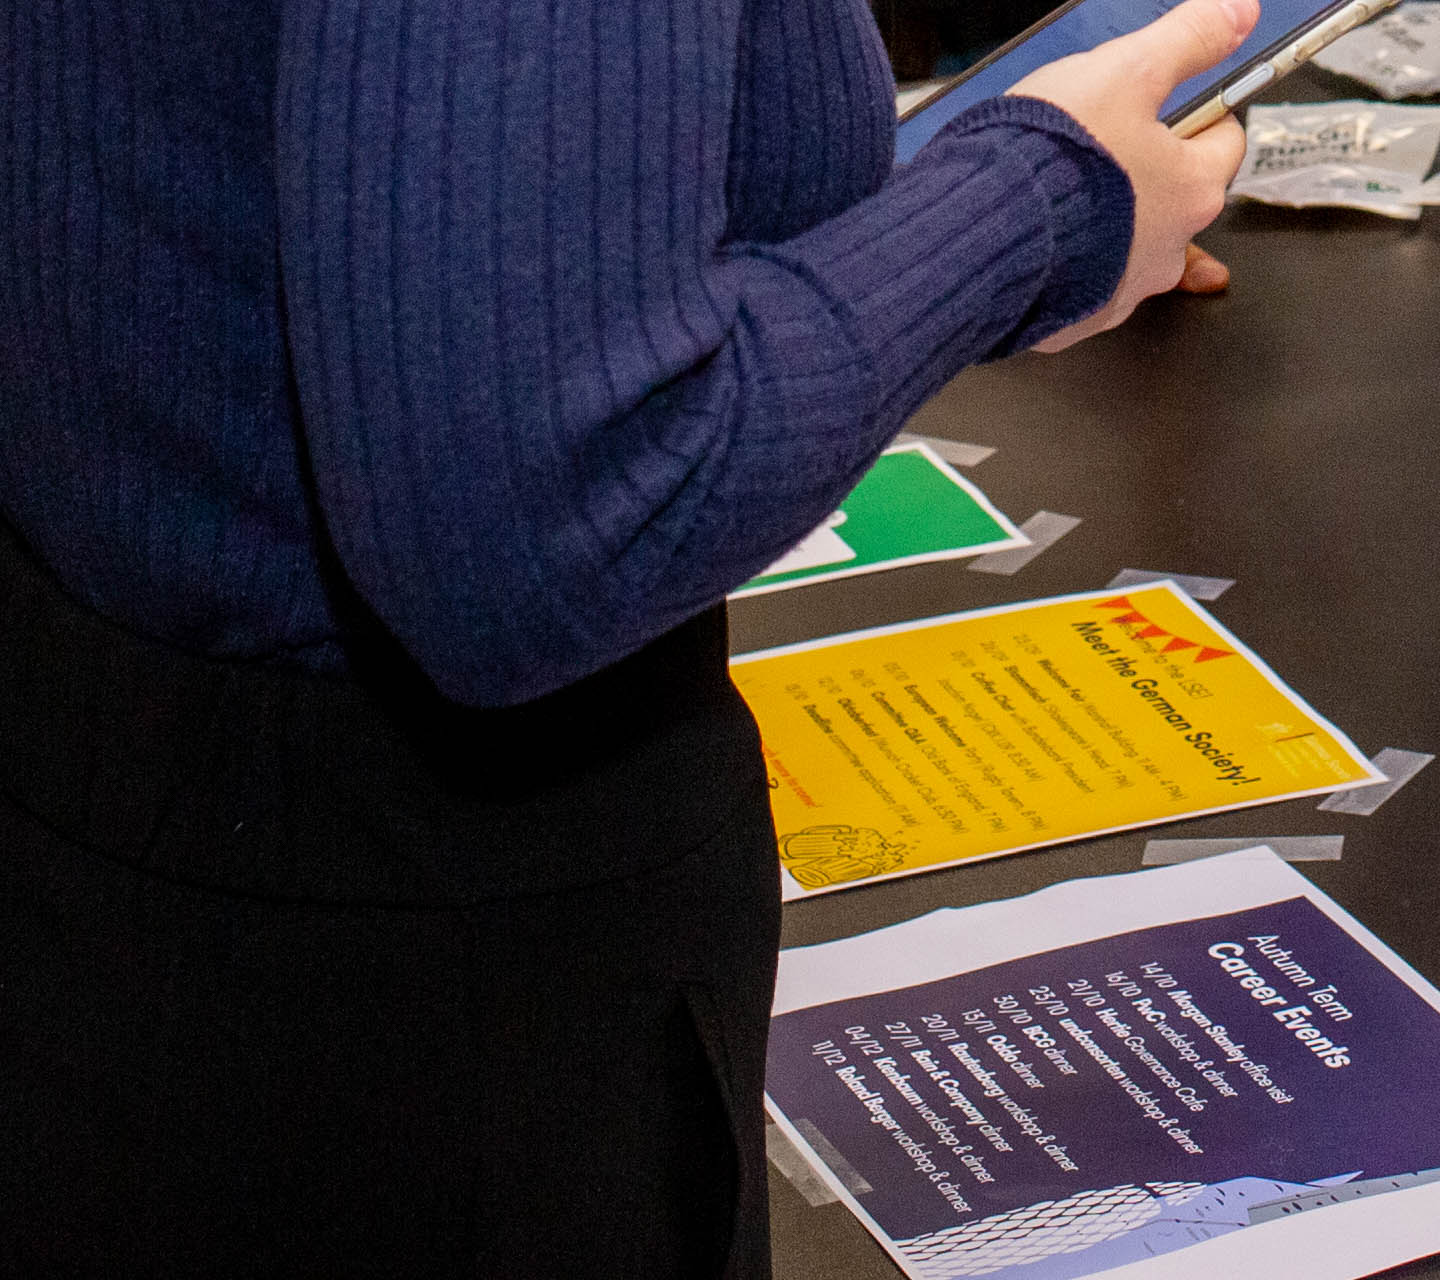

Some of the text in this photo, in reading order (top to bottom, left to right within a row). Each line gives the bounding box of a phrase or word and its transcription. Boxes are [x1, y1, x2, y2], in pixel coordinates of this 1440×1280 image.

[837, 698, 879, 737] Oktoberfest
[871, 691, 908, 727] Committee
[904, 684, 966, 747] European Welcome
[971, 672, 997, 694] Coffee
[993, 694, 1015, 711] Chat
[1071, 621, 1120, 655] Meet
[1107, 656, 1137, 677] the
[1131, 678, 1192, 731] German
[1184, 732, 1261, 786] Society!
[993, 994, 1078, 1075] 30/10 BCG dinner
[1105, 971, 1238, 1097] 16/10 PwC workshop & dinner
[1140, 962, 1294, 1104] 14/10 Morgan Stanley office visit
[1208, 942, 1350, 1068] Career Events
[1247, 935, 1352, 1021] Autumn Term
[844, 1026, 995, 1183] 04/12 Kienbaum workshop & dinner
[884, 1022, 1013, 1152] 27/11 Bain & Company dinner
[921, 1014, 1079, 1171] 20/11 Rautenberg workshop & dinner
[986, 1035, 1021, 1062] Oddo
[1010, 1062, 1045, 1088] dinner
[1028, 986, 1204, 1154] 23/10 undconsorten workshop & dinner
[1067, 979, 1208, 1112] 21/10 Hertie Governance Cafe
[812, 1040, 972, 1212] 11/12 Roland Berger workshop & dinner
